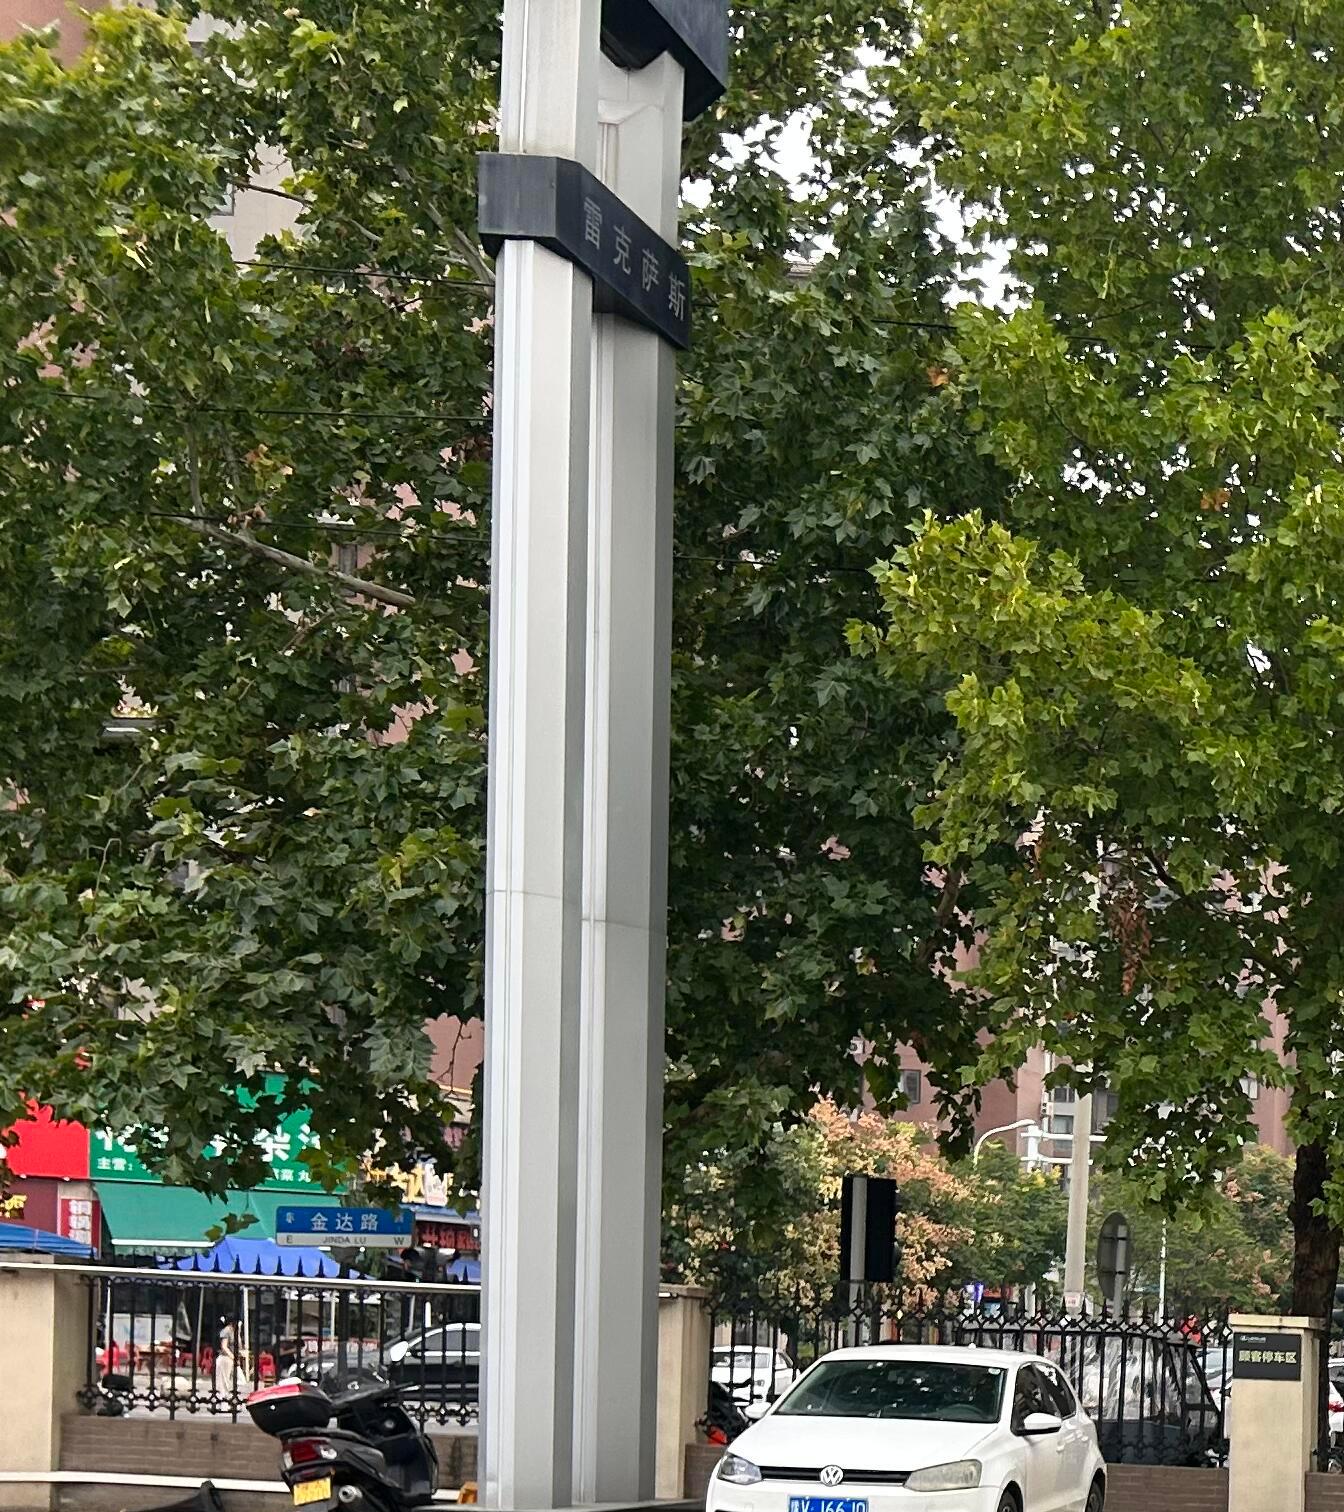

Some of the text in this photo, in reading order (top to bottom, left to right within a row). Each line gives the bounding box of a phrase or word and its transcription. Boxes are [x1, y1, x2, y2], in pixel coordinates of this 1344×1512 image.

[583, 196, 685, 321] 雷克萨斯
[310, 1212, 379, 1231] 金达路
[286, 1234, 405, 1245] E JINDA LU W
